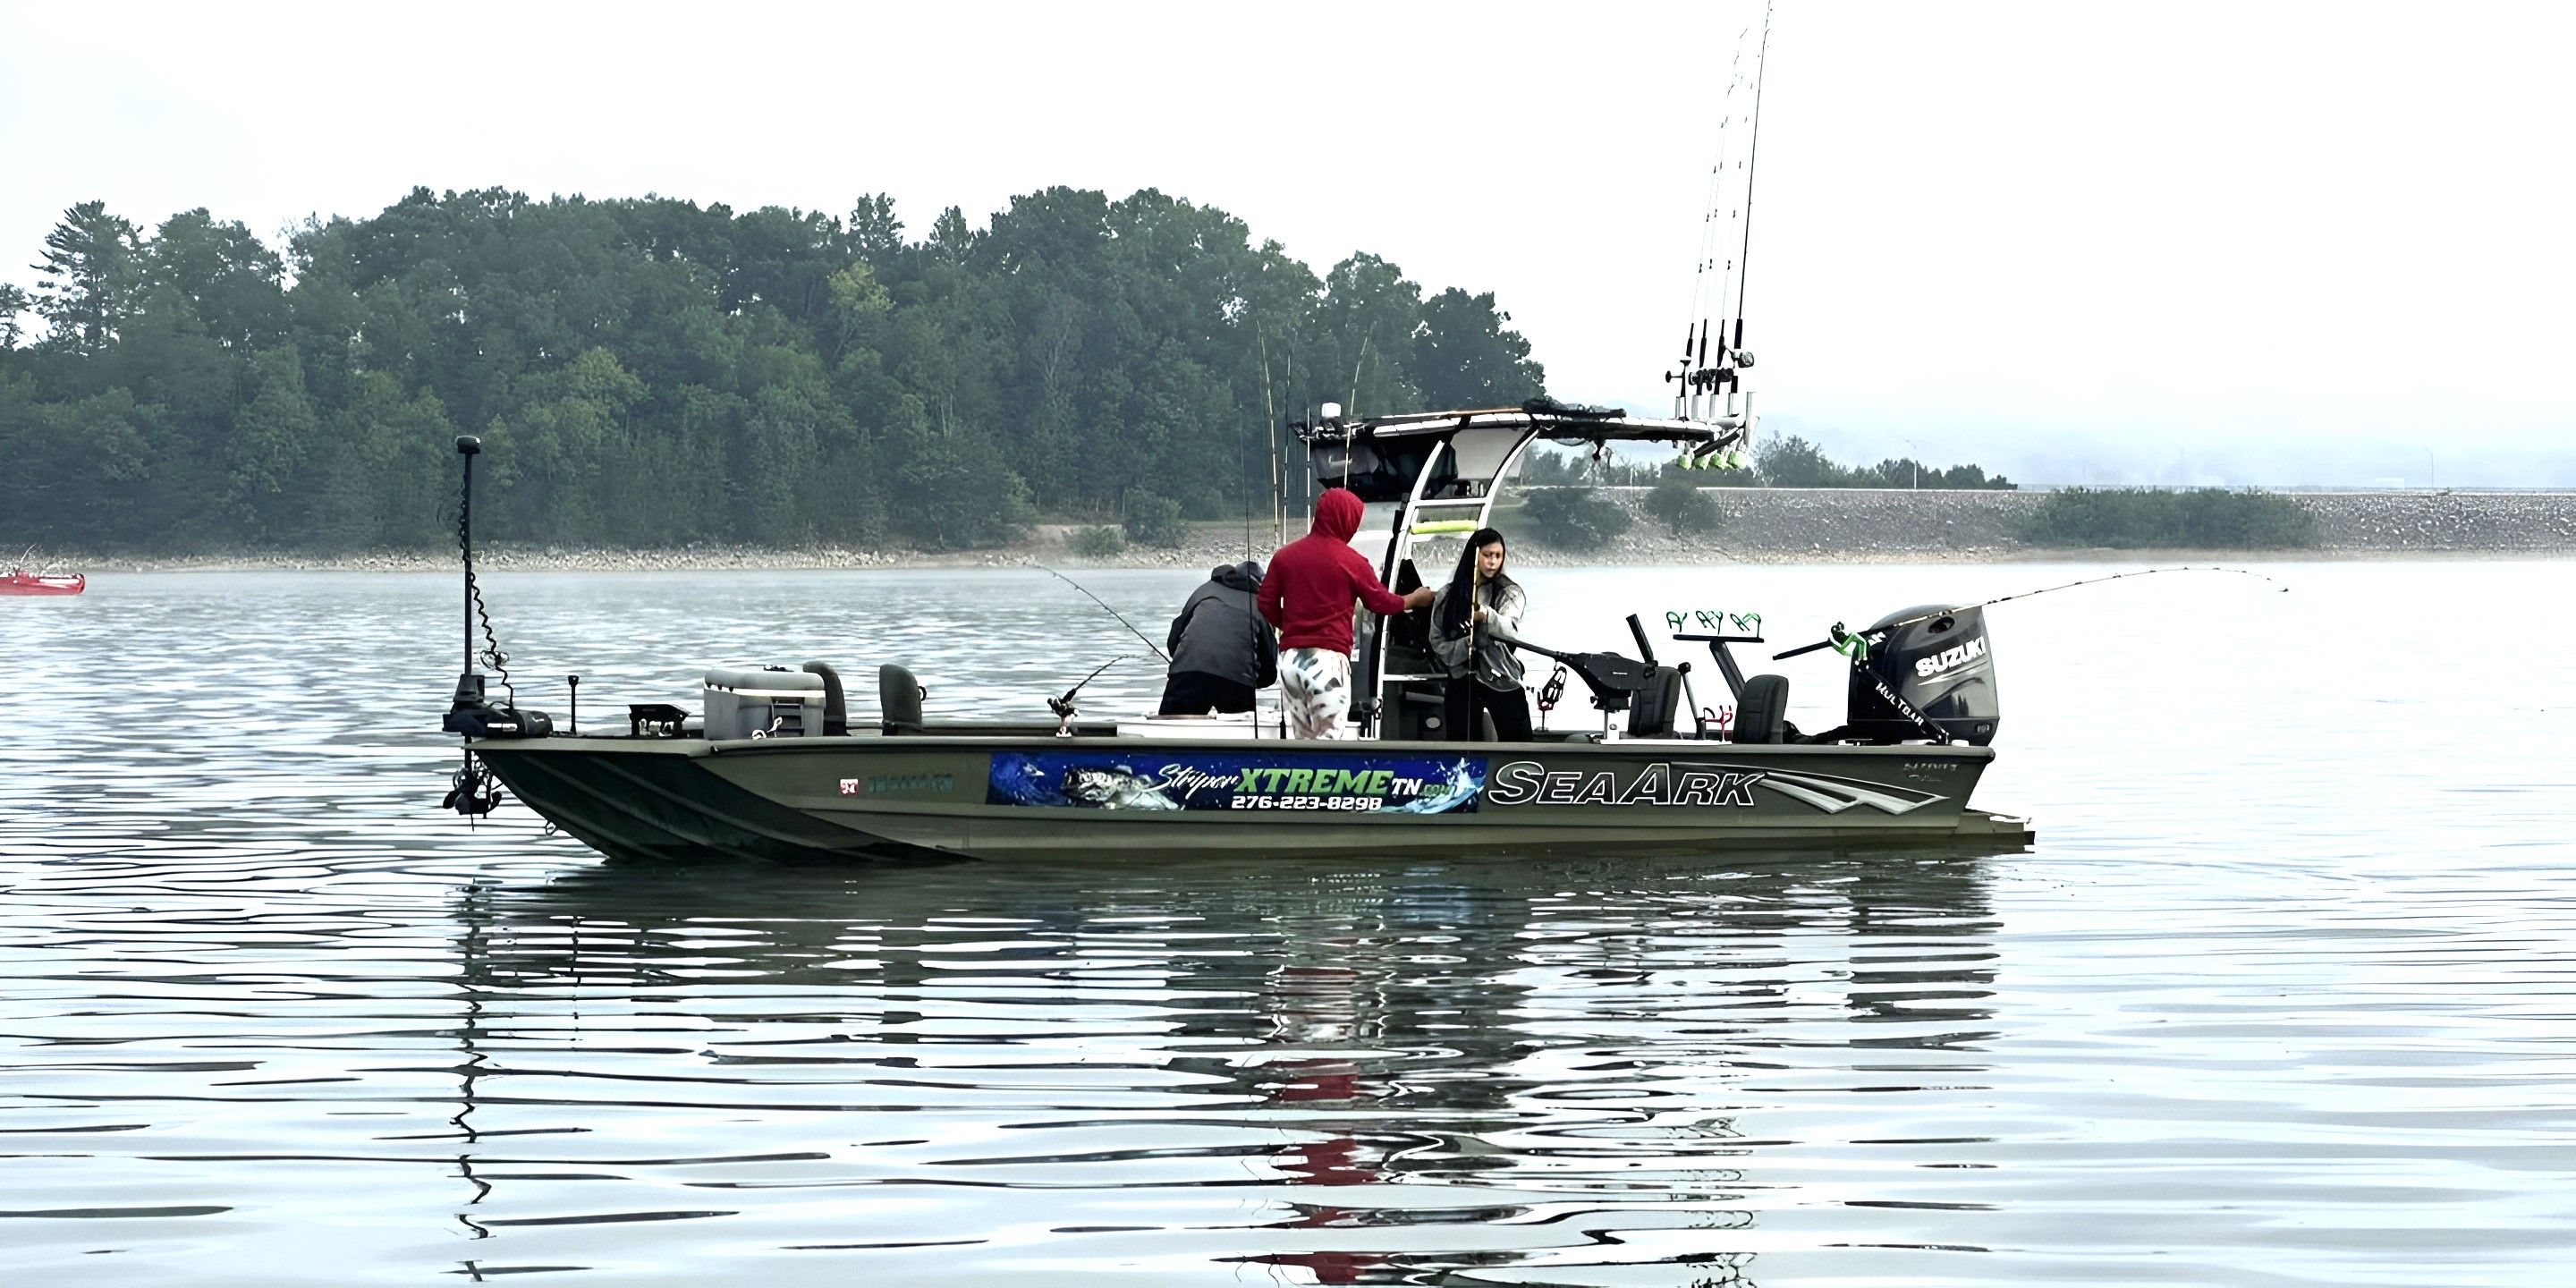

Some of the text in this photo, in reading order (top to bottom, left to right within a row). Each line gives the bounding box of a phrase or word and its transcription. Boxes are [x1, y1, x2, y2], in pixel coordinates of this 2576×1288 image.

[1915, 636, 1987, 677] SUZUKI
[1140, 764, 1240, 800] Striper
[1233, 768, 1394, 794] XTREME
[1231, 795, 1383, 810] 276-223-8298
